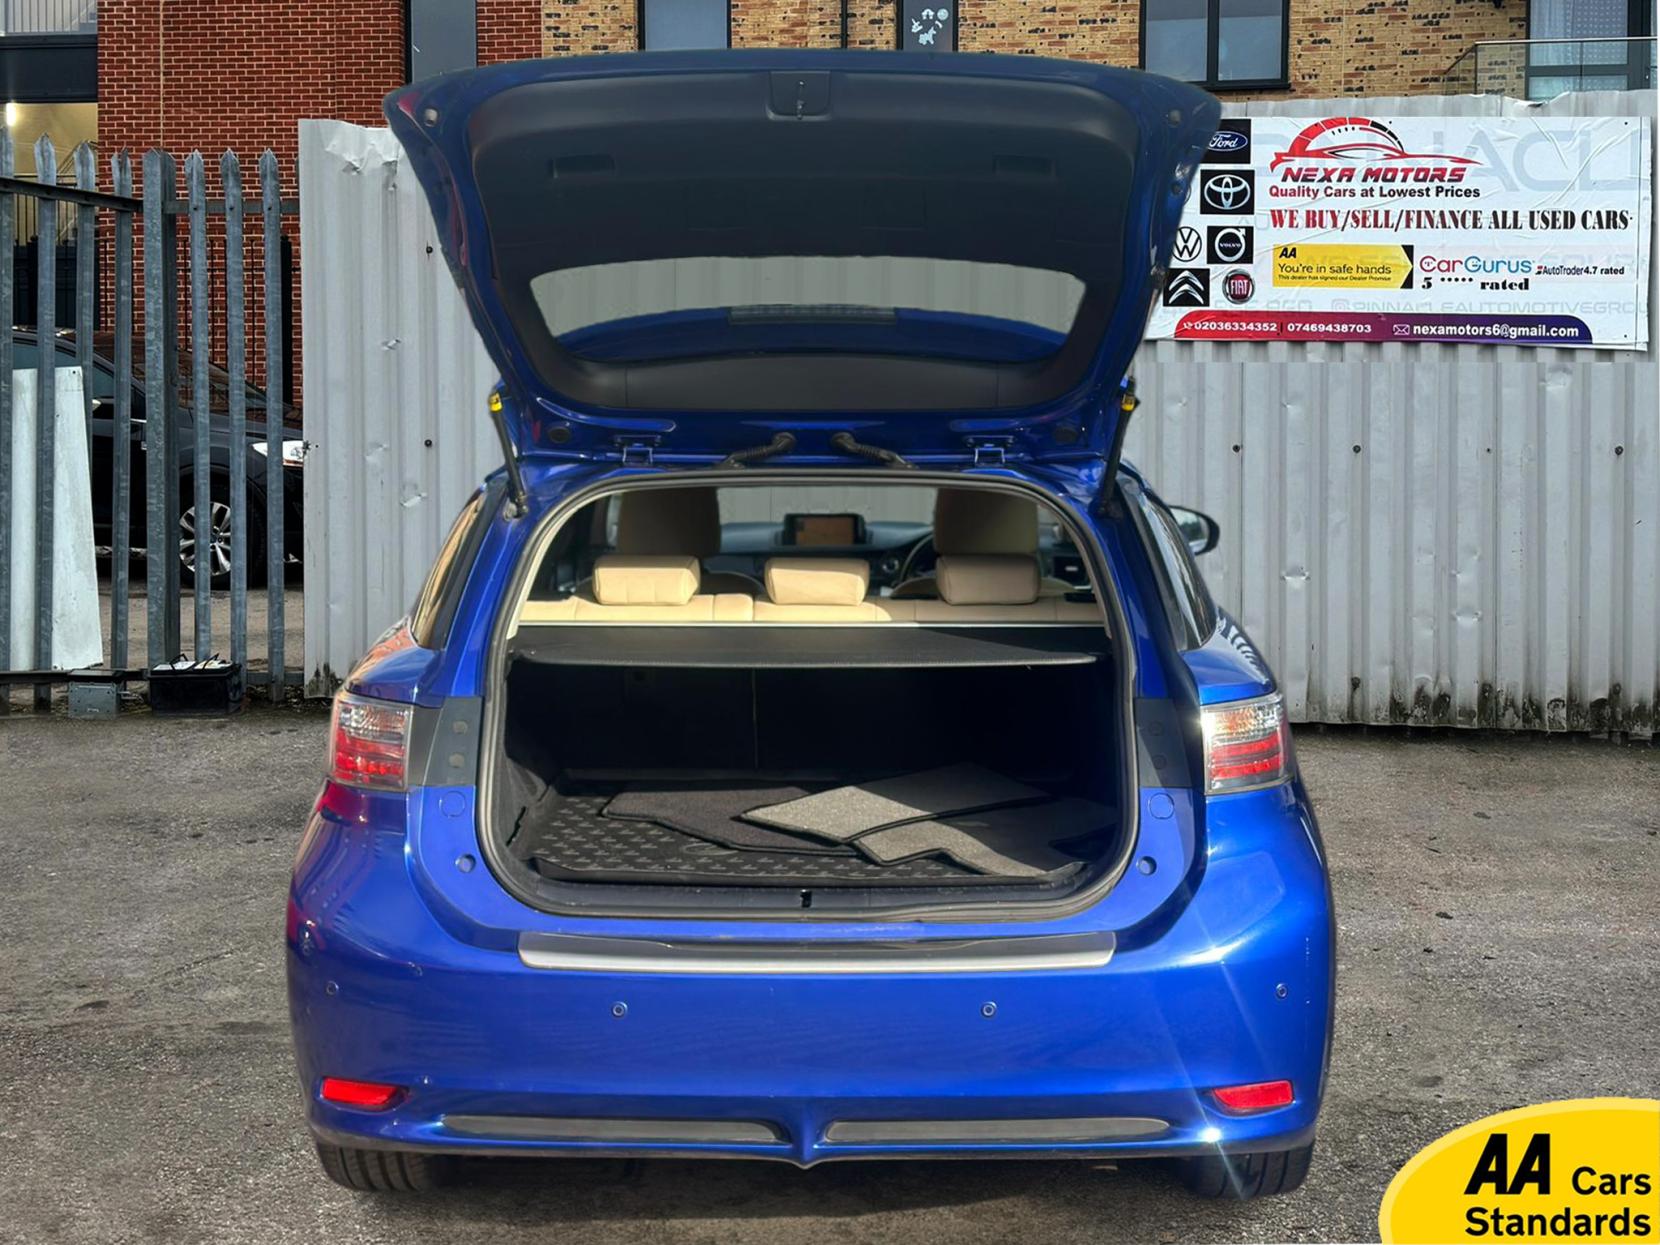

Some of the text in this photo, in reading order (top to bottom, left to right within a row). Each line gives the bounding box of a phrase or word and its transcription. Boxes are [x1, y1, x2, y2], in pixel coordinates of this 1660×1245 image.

[1209, 133, 1238, 148] Ford
[1281, 167, 1467, 183] NEXA MOTORS
[1269, 185, 1481, 200] Quality Cars at Lowest Prices
[1269, 209, 1299, 229] WE
[1305, 209, 1483, 232] BUY/SELL/FINANCE
[1488, 210, 1523, 230] ALL
[1528, 210, 1576, 230] USED
[1279, 247, 1297, 259] AA
[1278, 263, 1392, 274] You're in safe hands
[1419, 255, 1532, 273] CarGurus
[1600, 266, 1625, 275] rated
[1230, 280, 1248, 296] FIAT
[1421, 277, 1529, 291] 5 rated
[1194, 322, 1372, 333] 02036334352 07469438703
[1413, 324, 1579, 339] nexamotors6@gmail.com
